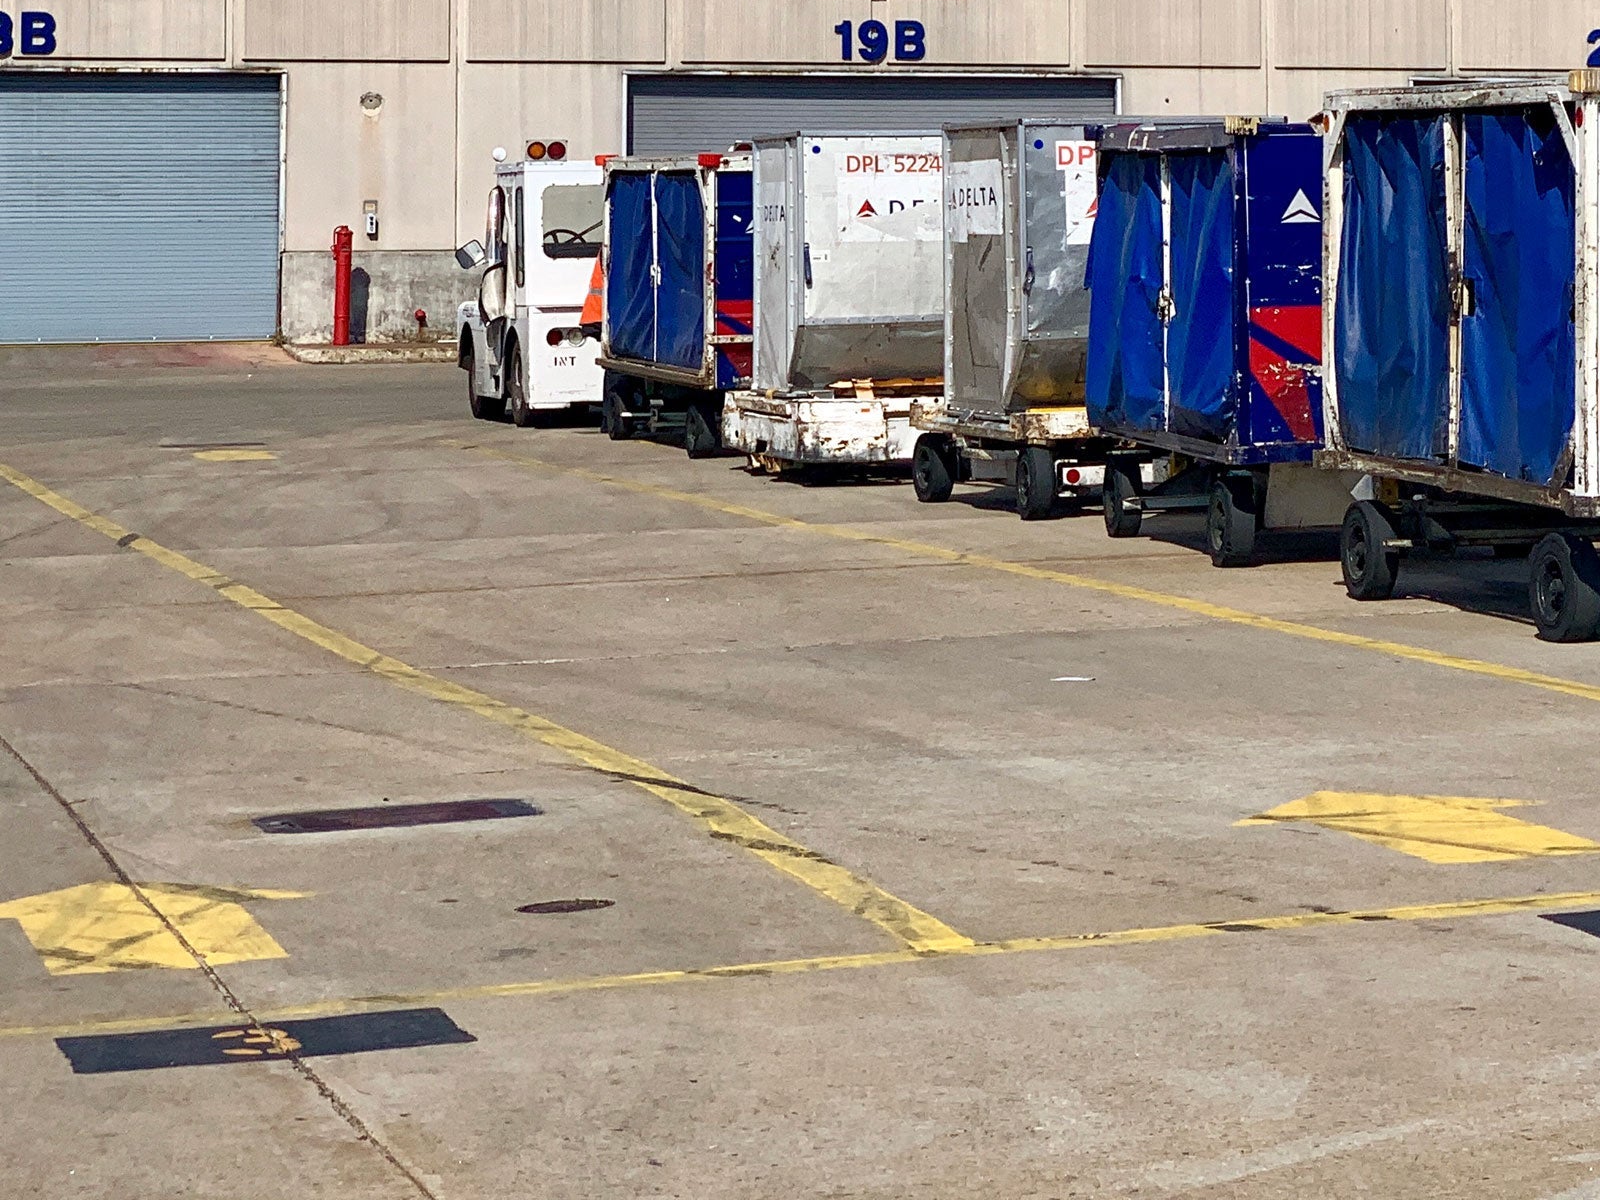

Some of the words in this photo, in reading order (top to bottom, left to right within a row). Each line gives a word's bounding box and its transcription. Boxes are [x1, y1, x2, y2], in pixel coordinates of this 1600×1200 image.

[834, 19, 926, 63] 19B
[846, 155, 884, 174] DPL
[894, 155, 943, 173] 5224
[958, 186, 997, 207] DELTA
[763, 204, 786, 222] DELTA
